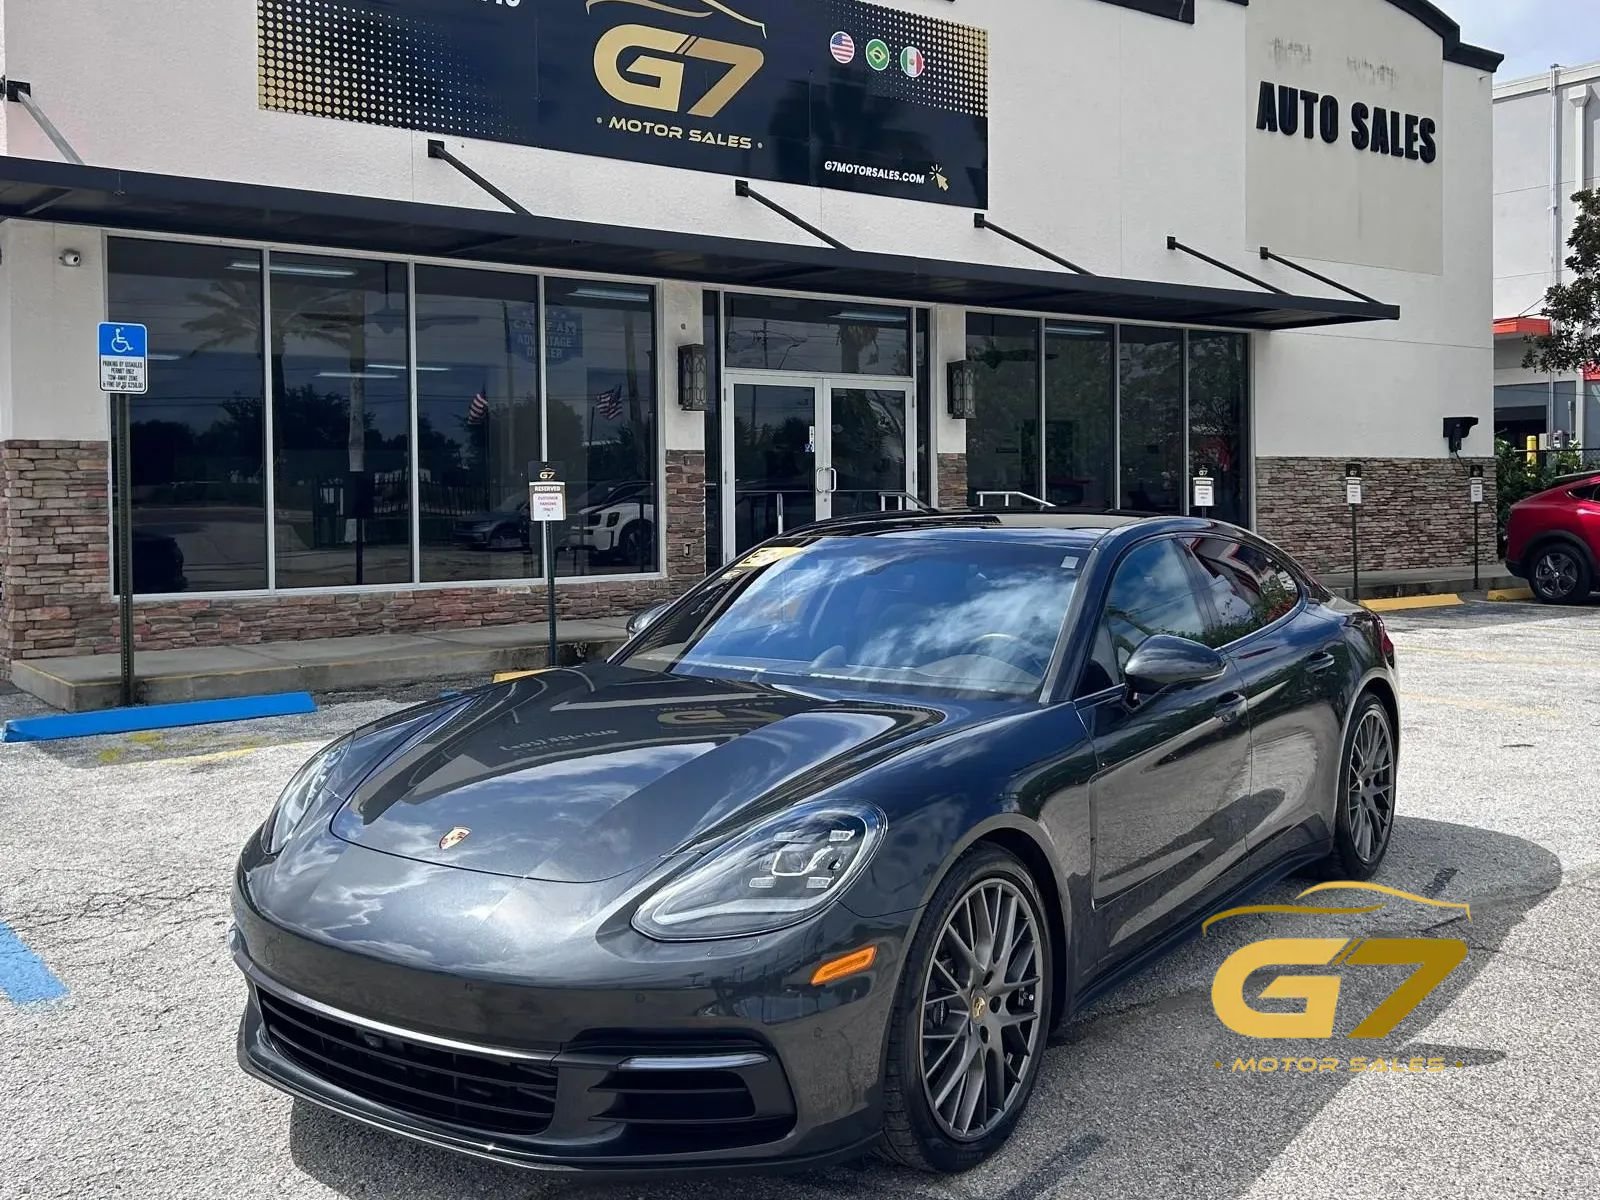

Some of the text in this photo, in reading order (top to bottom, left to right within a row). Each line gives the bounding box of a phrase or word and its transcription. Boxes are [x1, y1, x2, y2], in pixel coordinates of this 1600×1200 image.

[593, 24, 765, 118] G7
[608, 116, 752, 149] MOTOR SALES
[1256, 81, 1436, 163] AUTO SALES
[824, 161, 925, 184] G7MOTORSALES.COM
[540, 471, 555, 479] G7
